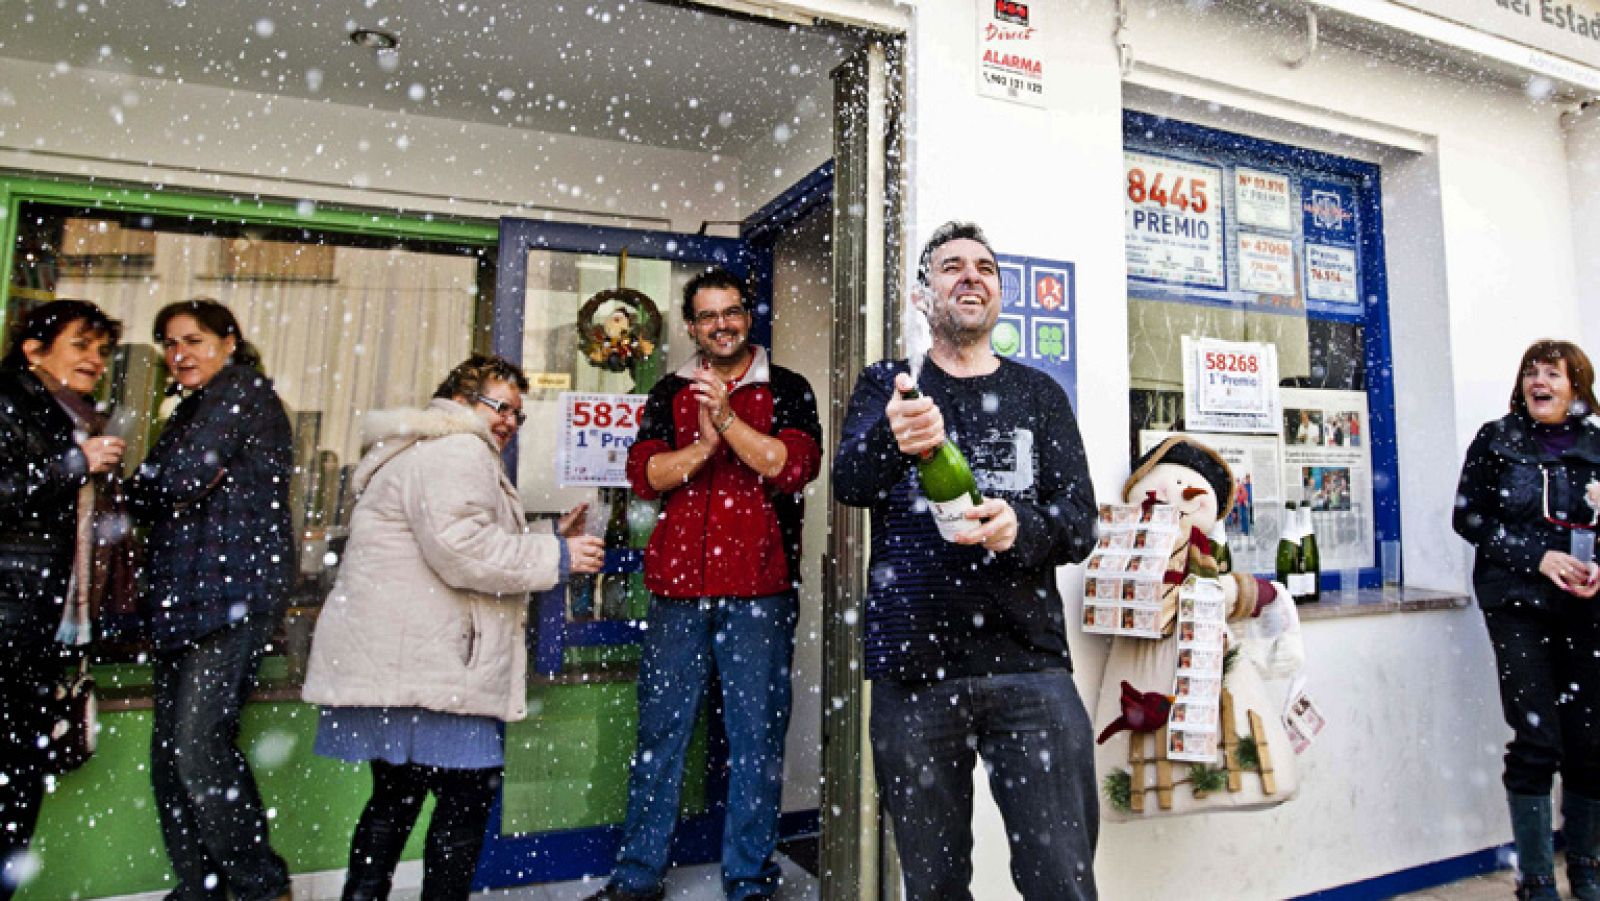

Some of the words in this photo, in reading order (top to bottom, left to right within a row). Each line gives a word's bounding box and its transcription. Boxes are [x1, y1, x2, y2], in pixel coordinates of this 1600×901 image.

[983, 49, 1042, 73] ALARMA
[1127, 168, 1207, 214] 8445
[1133, 210, 1209, 239] PREMIO
[1205, 351, 1258, 373] 58268
[1221, 374, 1257, 388] Premio
[601, 432, 634, 448] Pre
